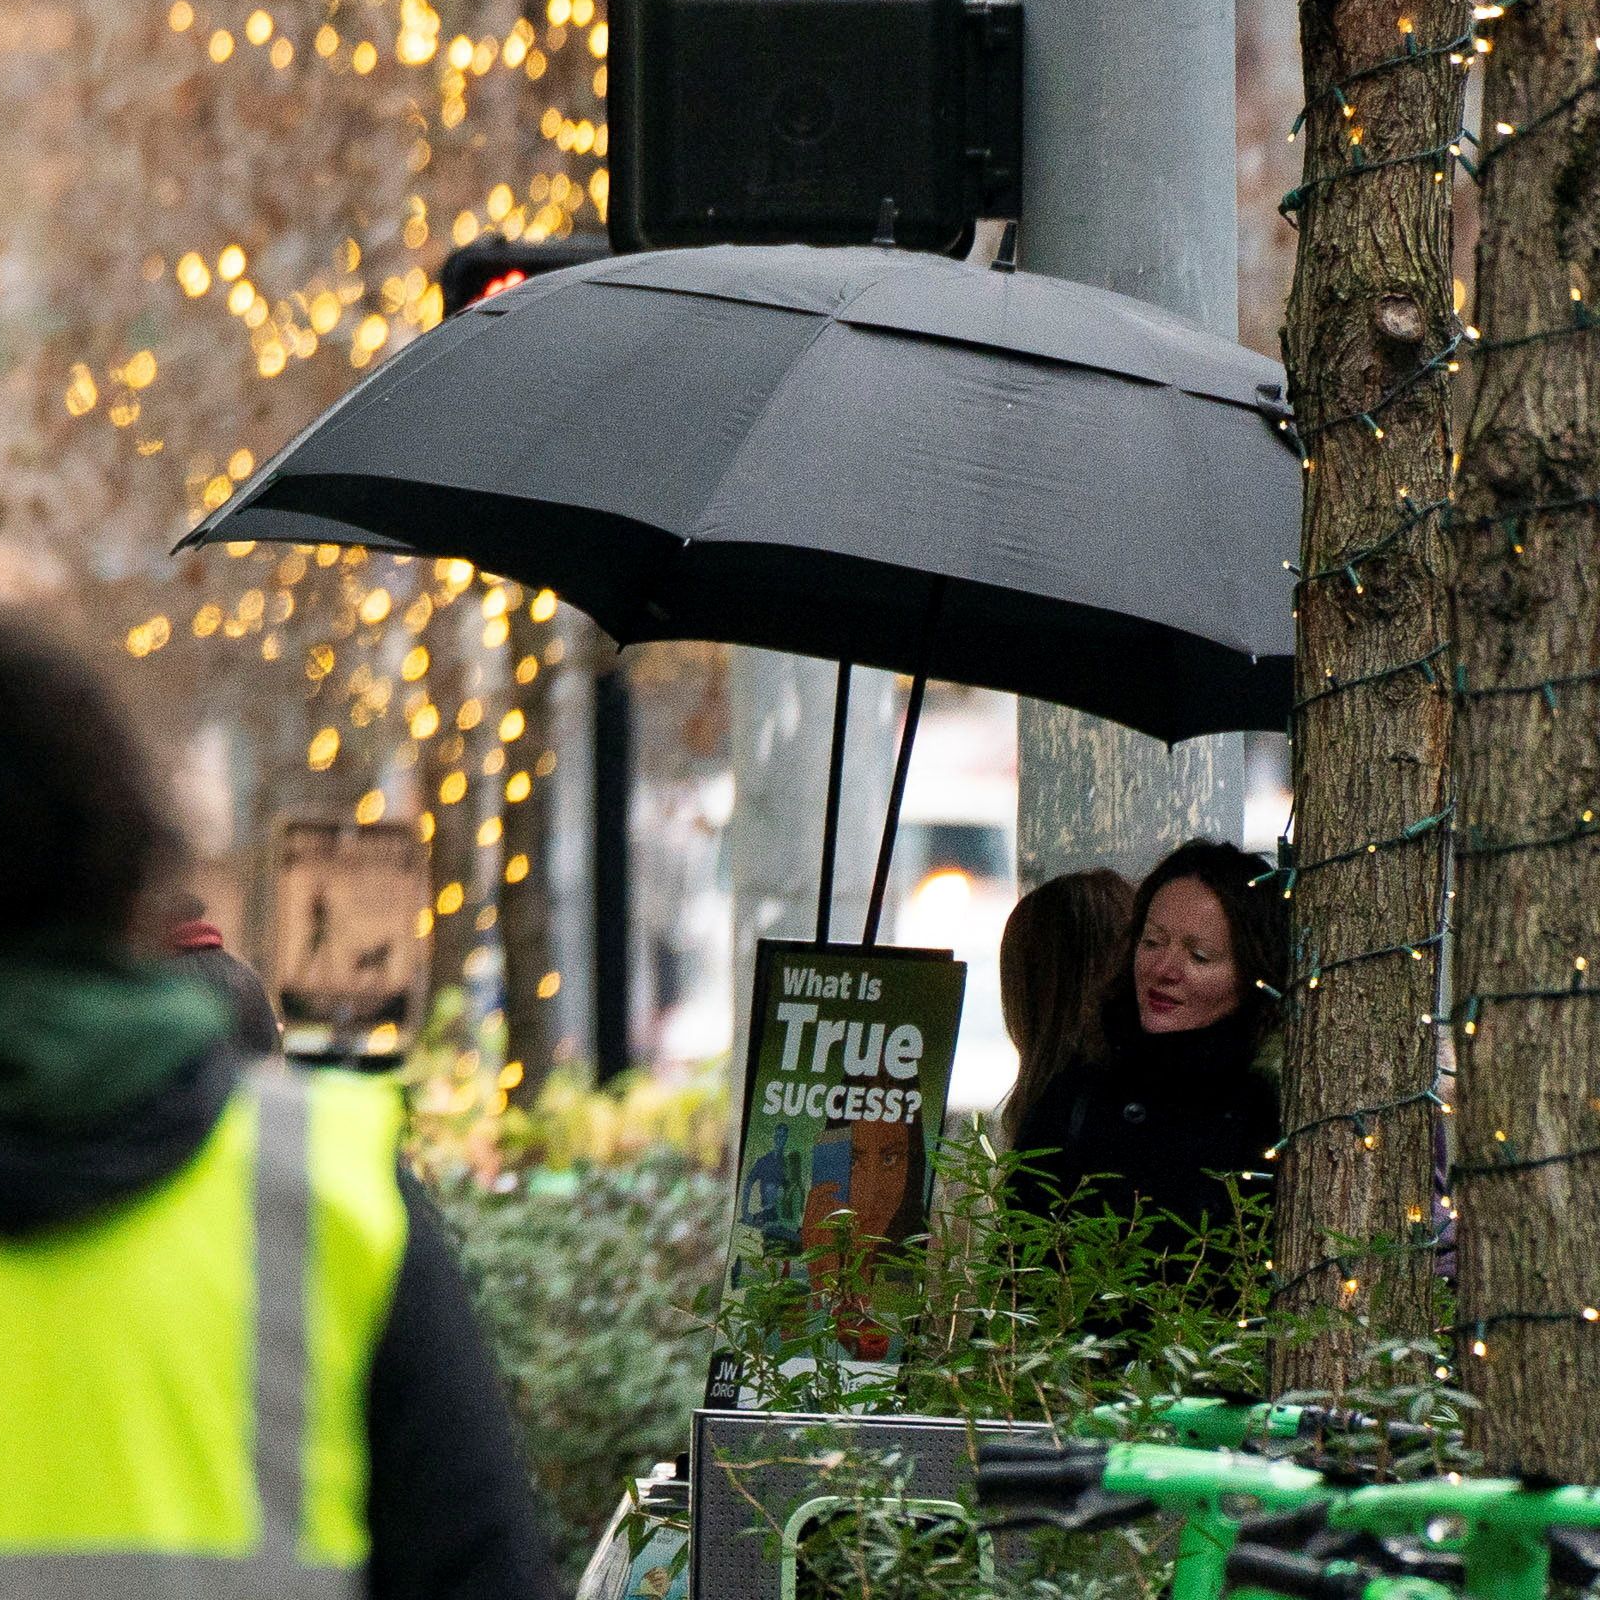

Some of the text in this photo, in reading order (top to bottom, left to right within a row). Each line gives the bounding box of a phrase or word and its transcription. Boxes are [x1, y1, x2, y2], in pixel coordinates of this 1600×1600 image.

[783, 966, 883, 1001] What Is
[776, 1002, 924, 1080] True
[761, 1080, 923, 1124] SUCCESS?
[714, 1360, 738, 1381] JW
